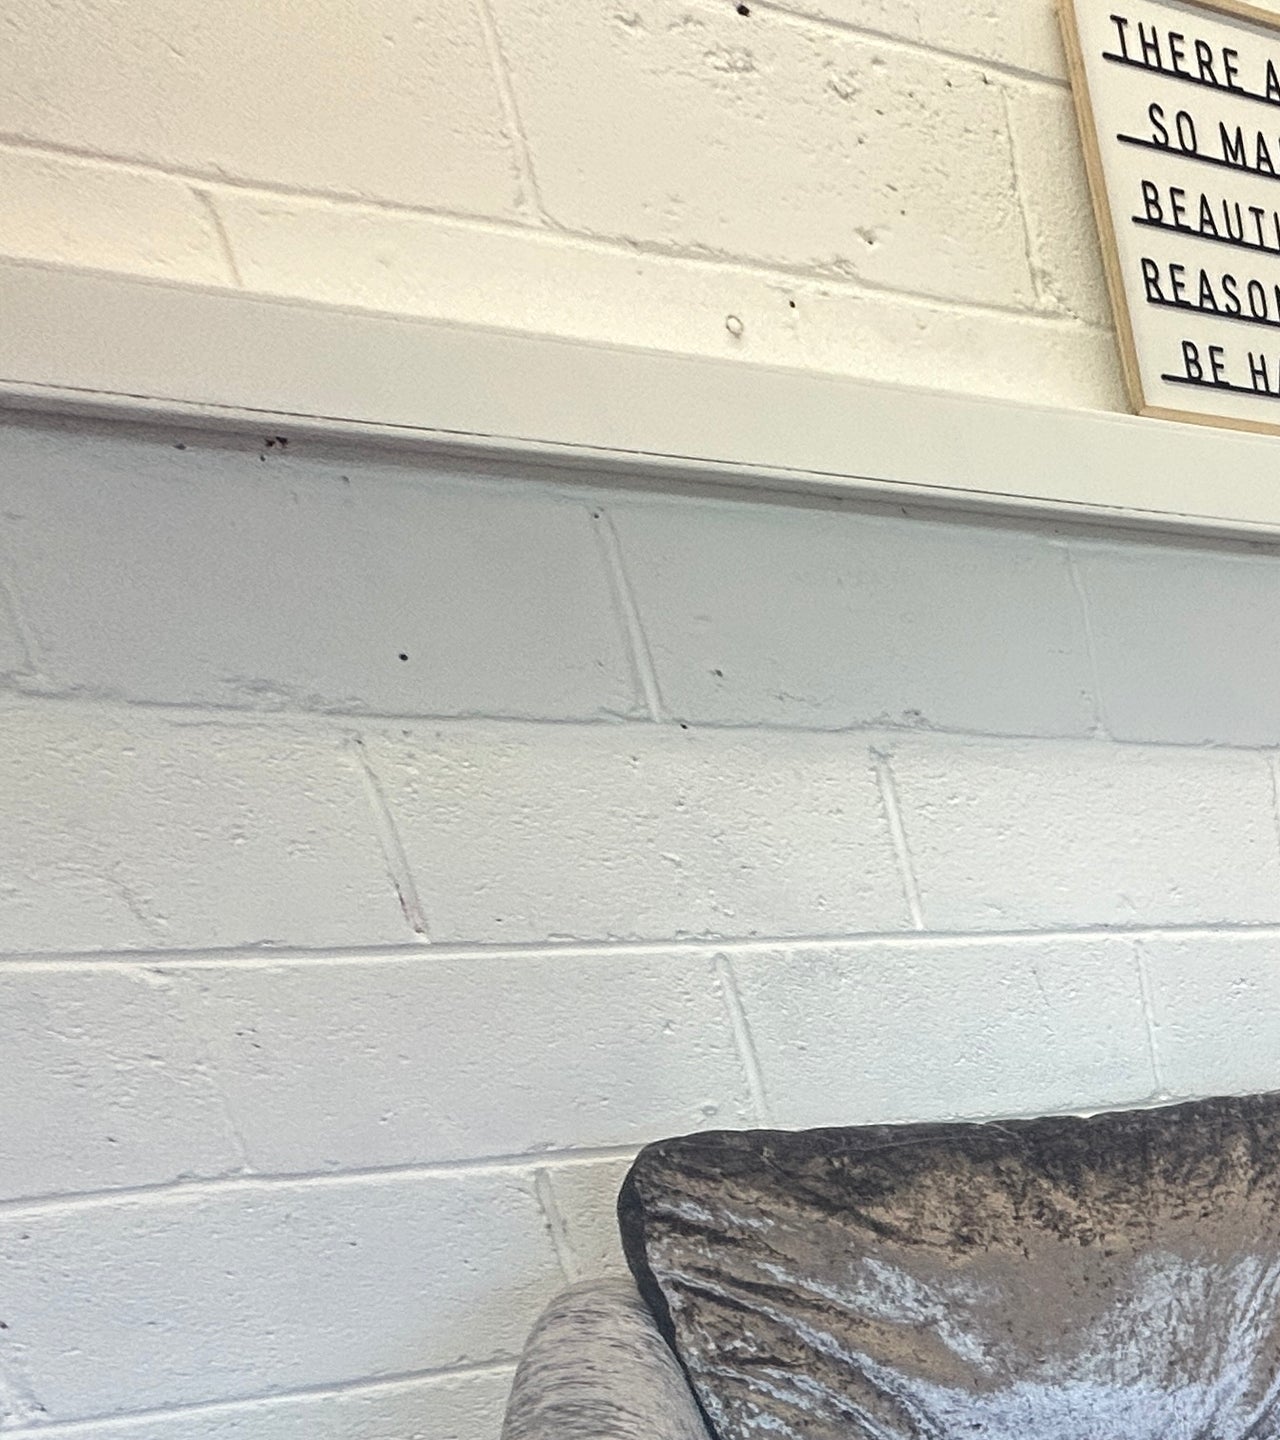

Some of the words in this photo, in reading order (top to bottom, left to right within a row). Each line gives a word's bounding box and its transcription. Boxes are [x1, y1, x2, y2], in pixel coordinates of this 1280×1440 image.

[1110, 14, 1243, 91] THERE
[1149, 103, 1198, 156] SO
[1182, 340, 1229, 385] BE
